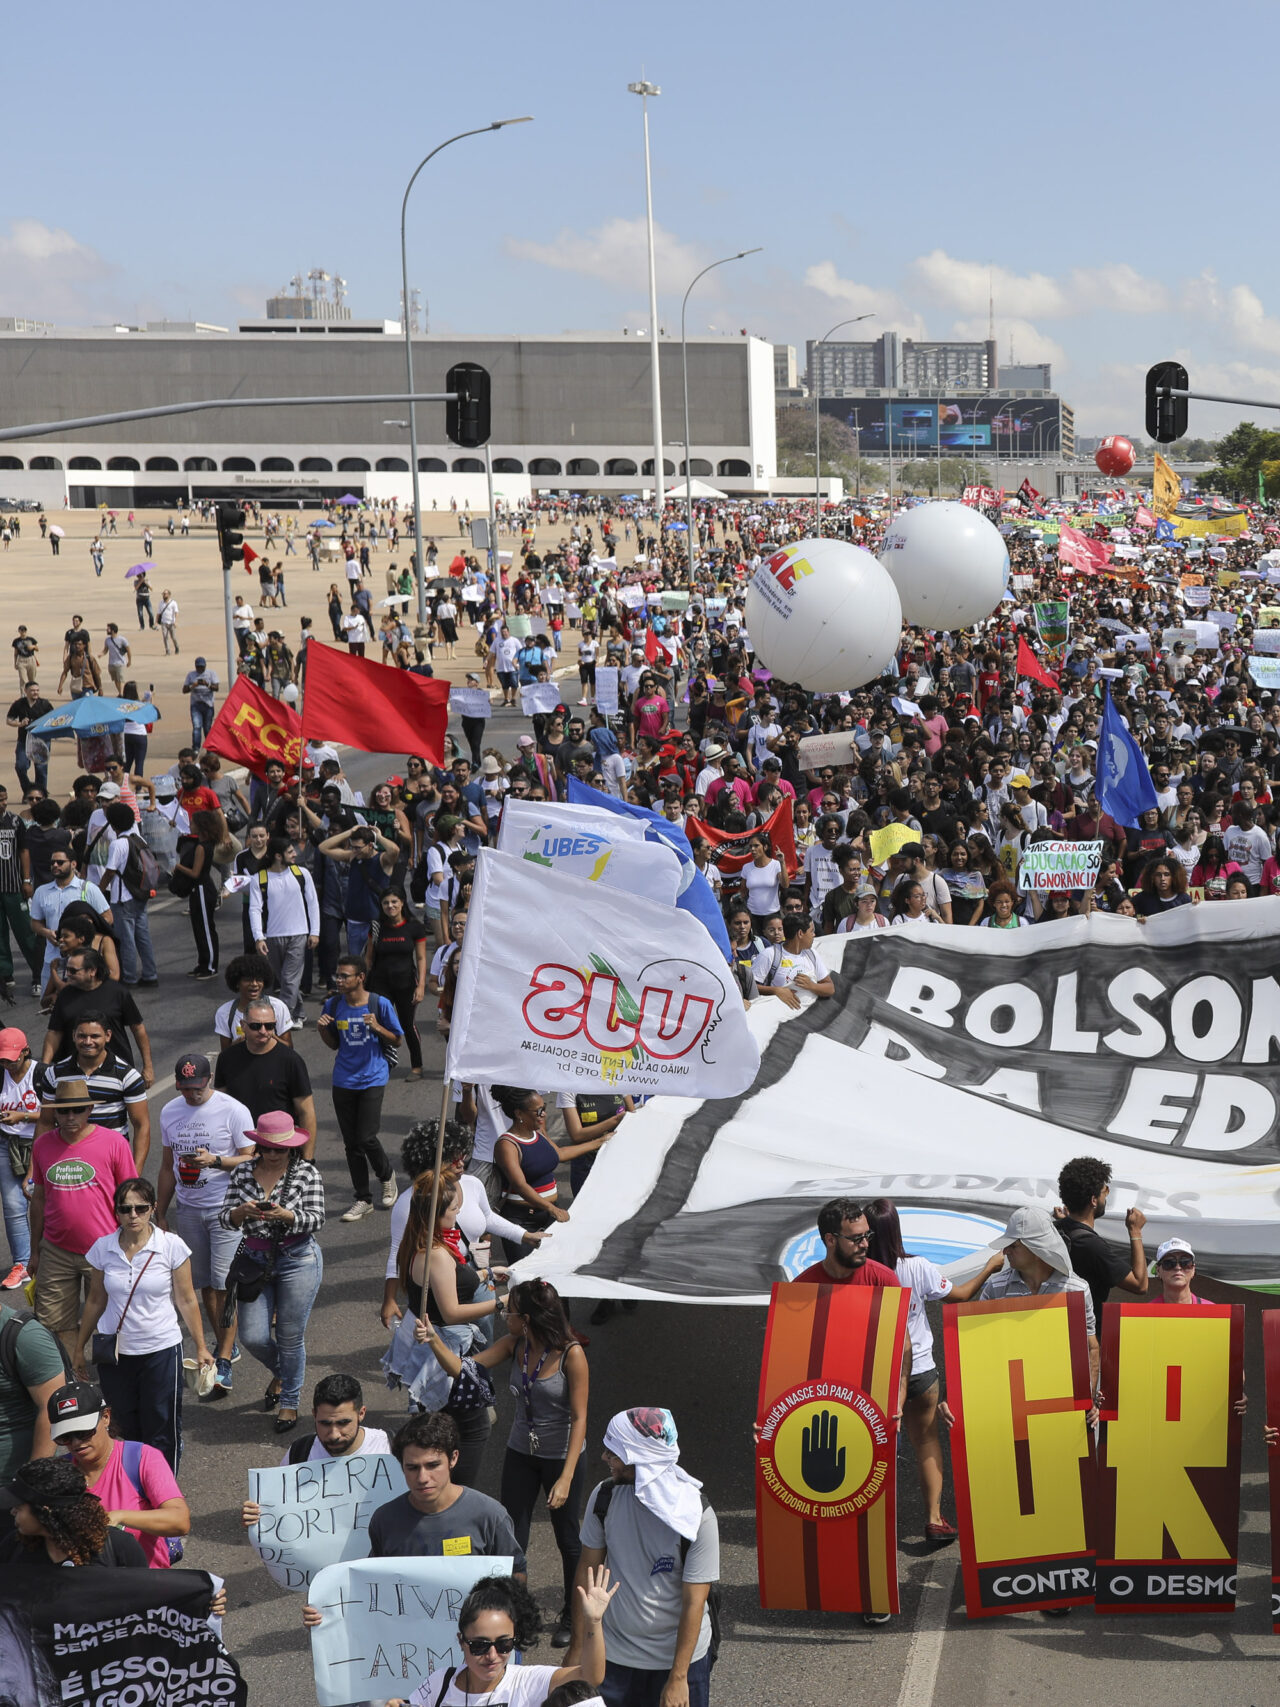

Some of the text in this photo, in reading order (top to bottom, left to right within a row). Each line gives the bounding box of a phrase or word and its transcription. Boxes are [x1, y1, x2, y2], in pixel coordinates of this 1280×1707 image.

[543, 838, 600, 857] UBES
[1024, 842, 1102, 853] MAIS CARA QUE A
[1023, 872, 1032, 888] A
[55, 1173, 83, 1181] Professor
[56, 1165, 83, 1173] Profissão
[761, 1382, 888, 1445] NINGUÉM NASCE SÓ PARA TRABALHAR
[256, 1456, 392, 1507] LIBERA
[760, 1457, 888, 1517] APOSENTADORIA É DIREITO DO CIDADÃO
[258, 1501, 371, 1543] PORTE
[259, 1547, 295, 1568] DE
[1109, 1575, 1134, 1595] O
[53, 1613, 143, 1640] MARIA
[54, 1636, 99, 1656] SEM
[102, 1627, 129, 1643] SE
[61, 1656, 236, 1700] É ISSO QUE
